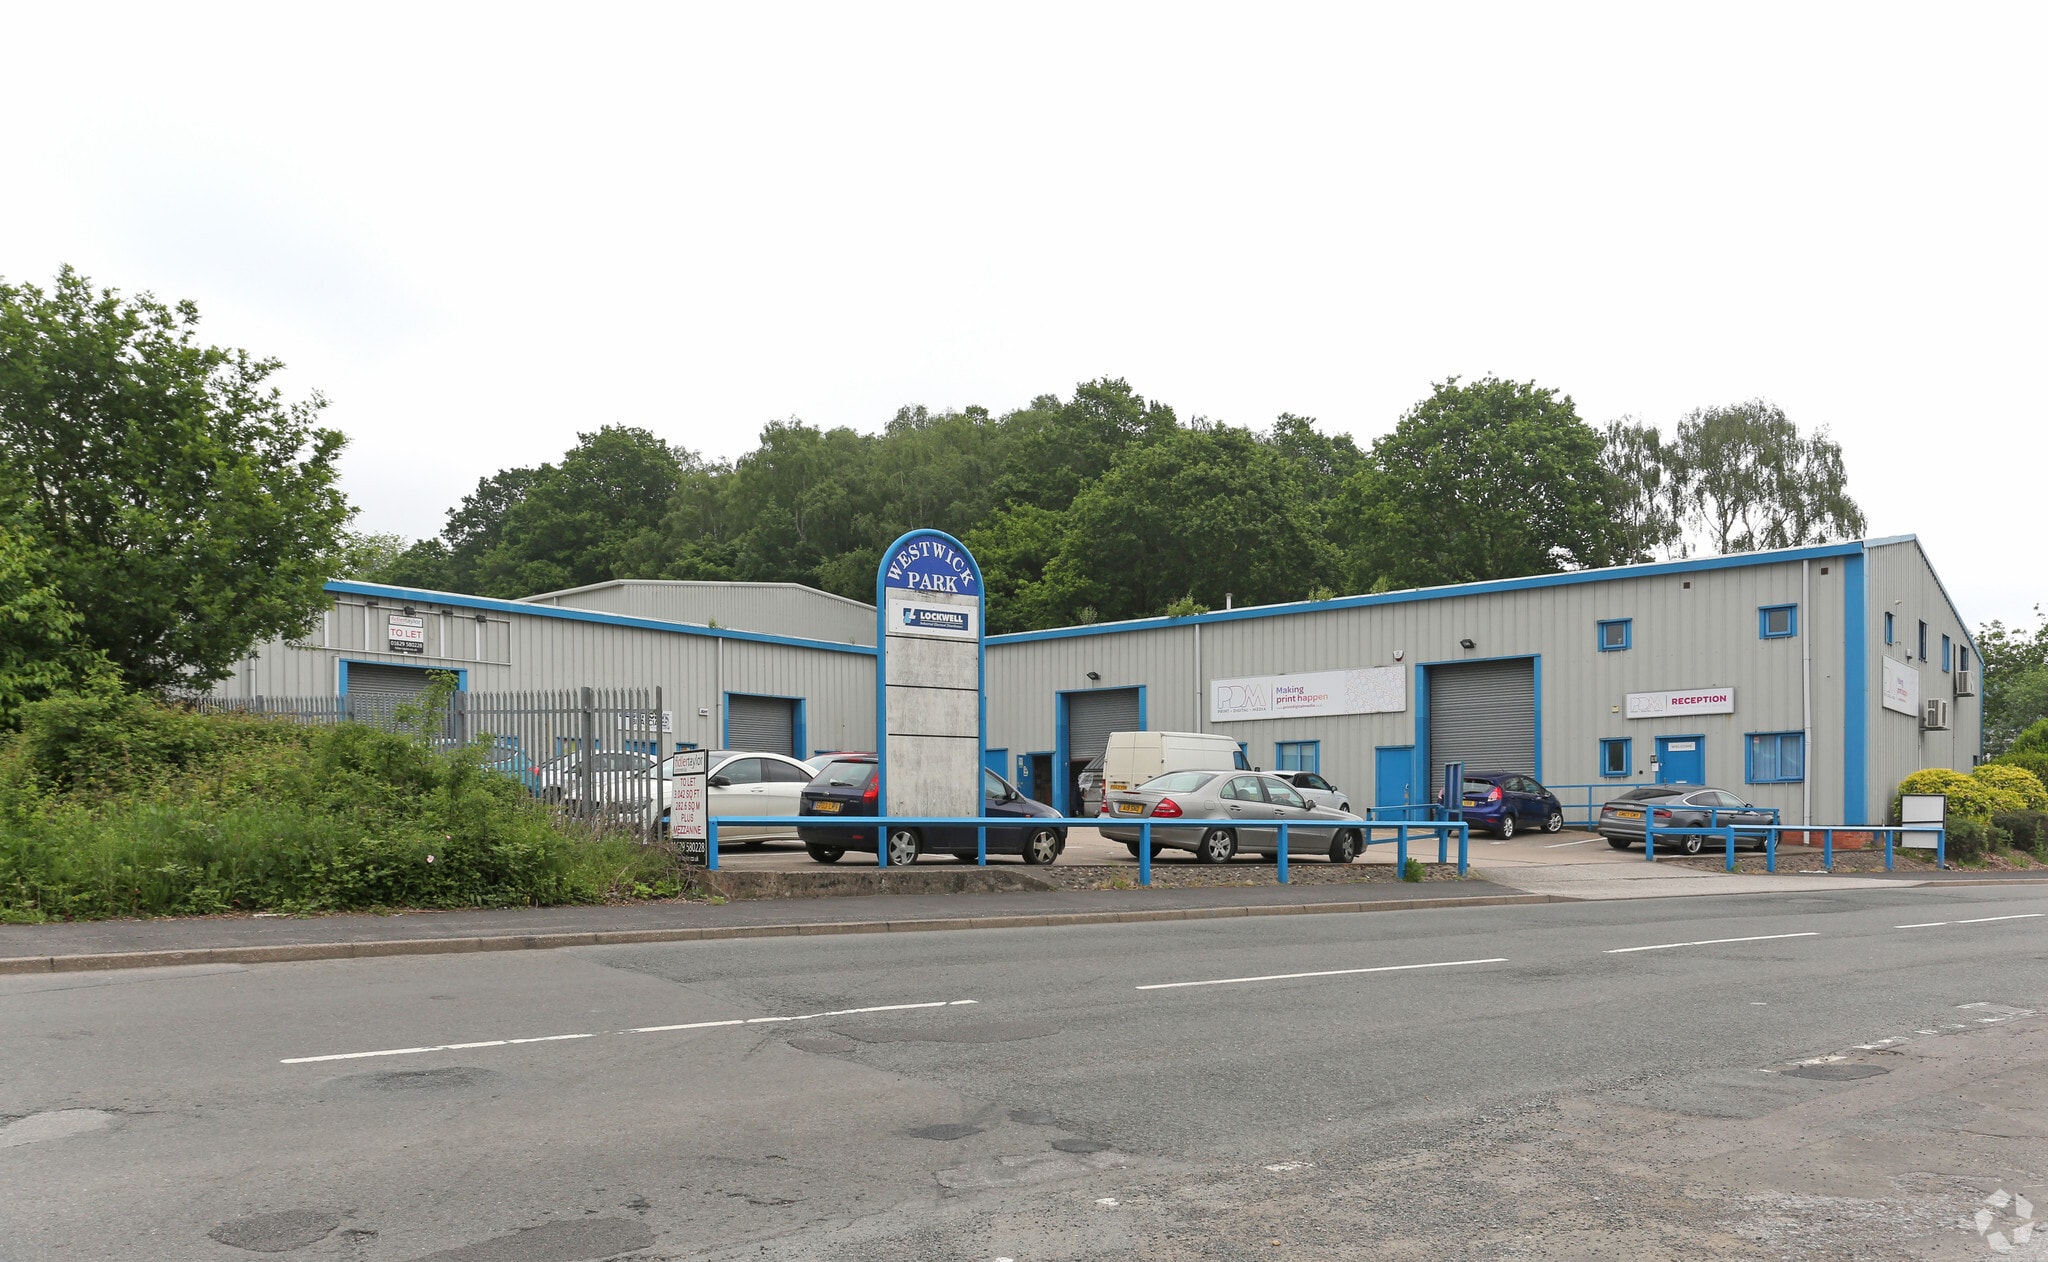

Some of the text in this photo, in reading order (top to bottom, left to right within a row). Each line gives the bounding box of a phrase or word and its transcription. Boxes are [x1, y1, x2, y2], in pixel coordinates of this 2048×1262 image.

[887, 541, 975, 588] WESTWICK
[907, 571, 958, 592] PARK
[920, 611, 964, 623] LOCKWELL
[390, 628, 402, 636] TO
[1217, 684, 1304, 709] PDM Making
[1276, 694, 1329, 704] print happen
[1671, 695, 1727, 705] RECEPTION
[680, 777, 696, 786] TO LET
[686, 789, 693, 800] SQ
[694, 789, 699, 798] FT
[688, 801, 695, 812] SQ
[696, 801, 701, 810] M
[681, 813, 694, 823] PLUS
[673, 825, 701, 835] MEZZANINE
[686, 841, 706, 853] 580228
